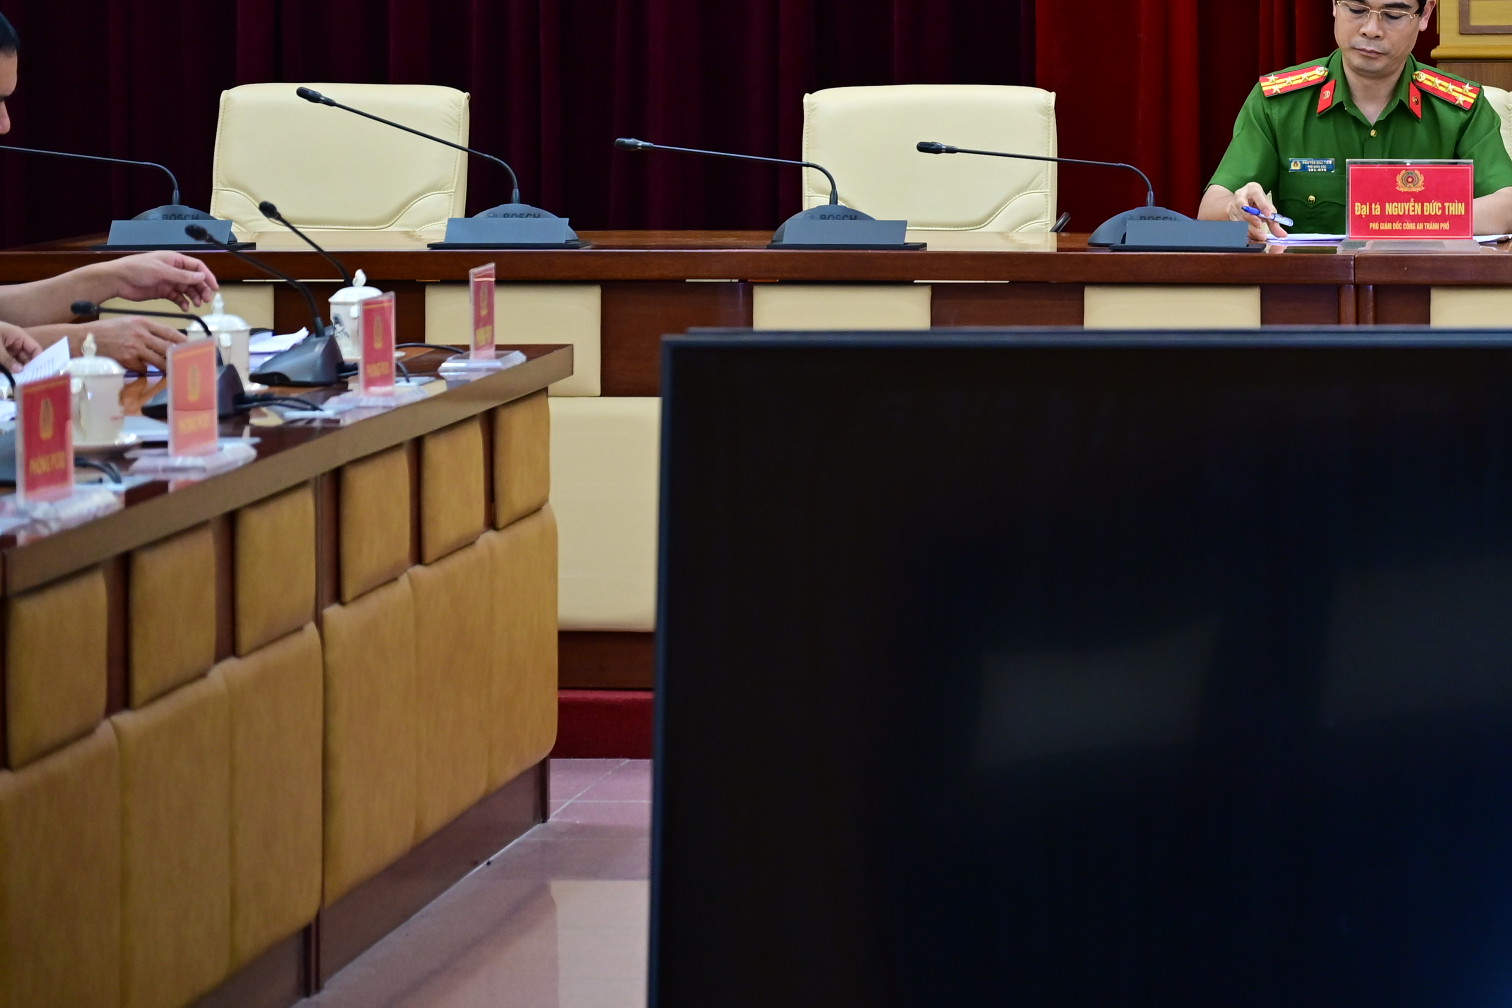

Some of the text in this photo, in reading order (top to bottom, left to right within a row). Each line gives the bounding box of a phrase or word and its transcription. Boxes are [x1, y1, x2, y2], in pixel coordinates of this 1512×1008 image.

[1354, 198, 1465, 218] Đại tá NGUYỄN ĐỨC THÌN
[1416, 222, 1424, 230] AN
